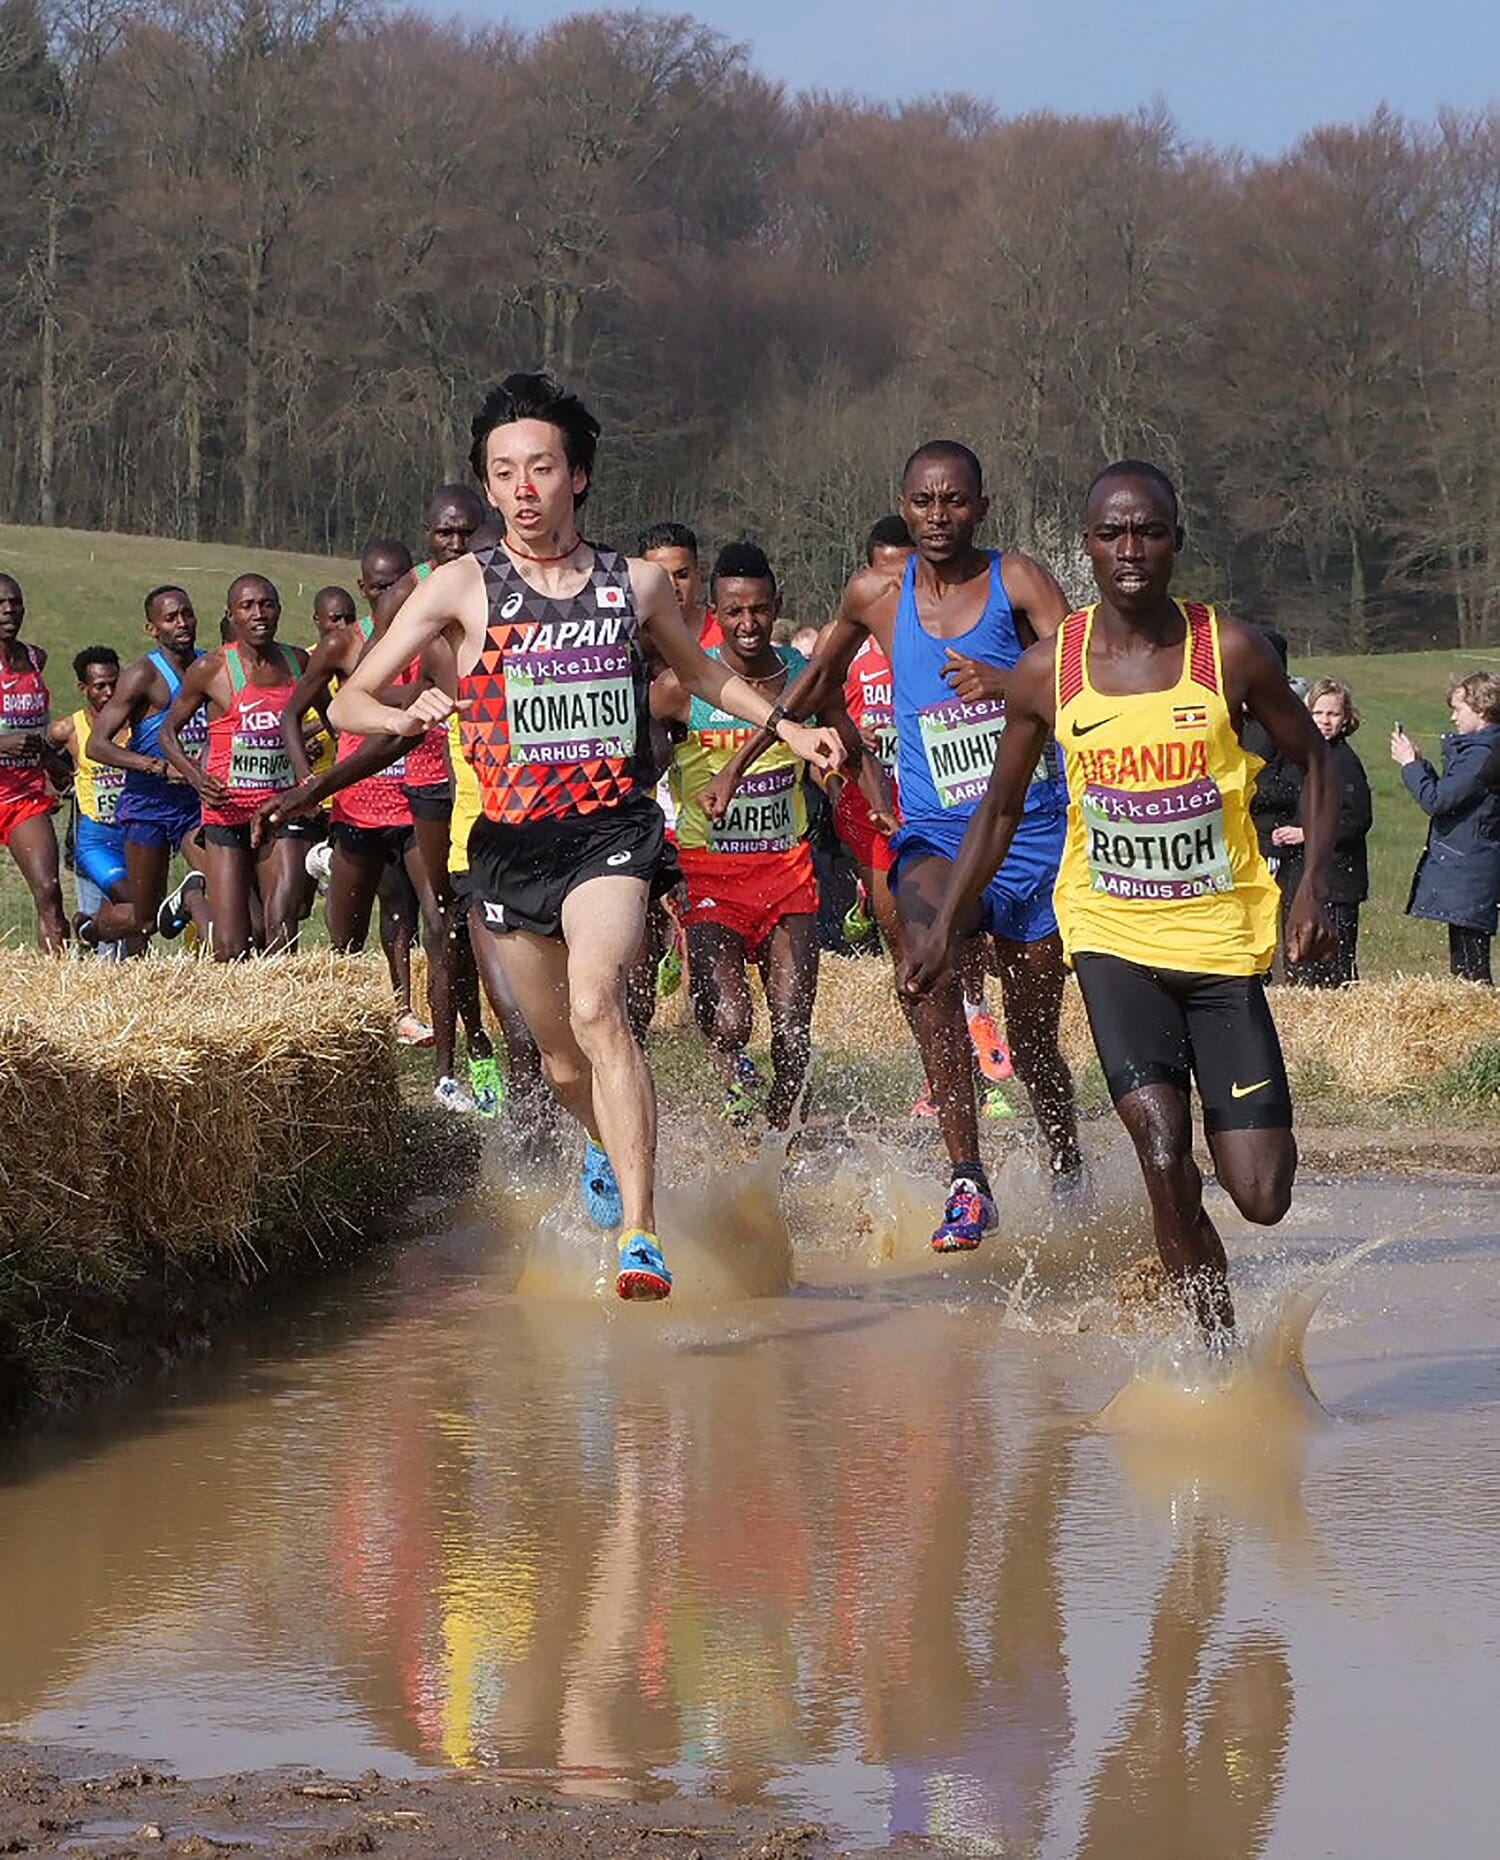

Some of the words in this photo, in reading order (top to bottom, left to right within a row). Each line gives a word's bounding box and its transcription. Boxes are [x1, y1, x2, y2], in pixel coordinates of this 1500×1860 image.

[512, 618, 621, 654] JAPAN
[507, 656, 627, 680] Mikkeller
[513, 688, 629, 733] KOMATSU
[517, 744, 590, 762] AARHUS
[931, 730, 1001, 778] MUHIT
[1078, 740, 1209, 785] UGANDA
[943, 780, 989, 803] AARH
[1083, 788, 1217, 818] Mikkeller
[711, 838, 769, 852] AARHUS
[1091, 823, 1216, 872] ROTICH
[1093, 873, 1174, 899] AARHUS
